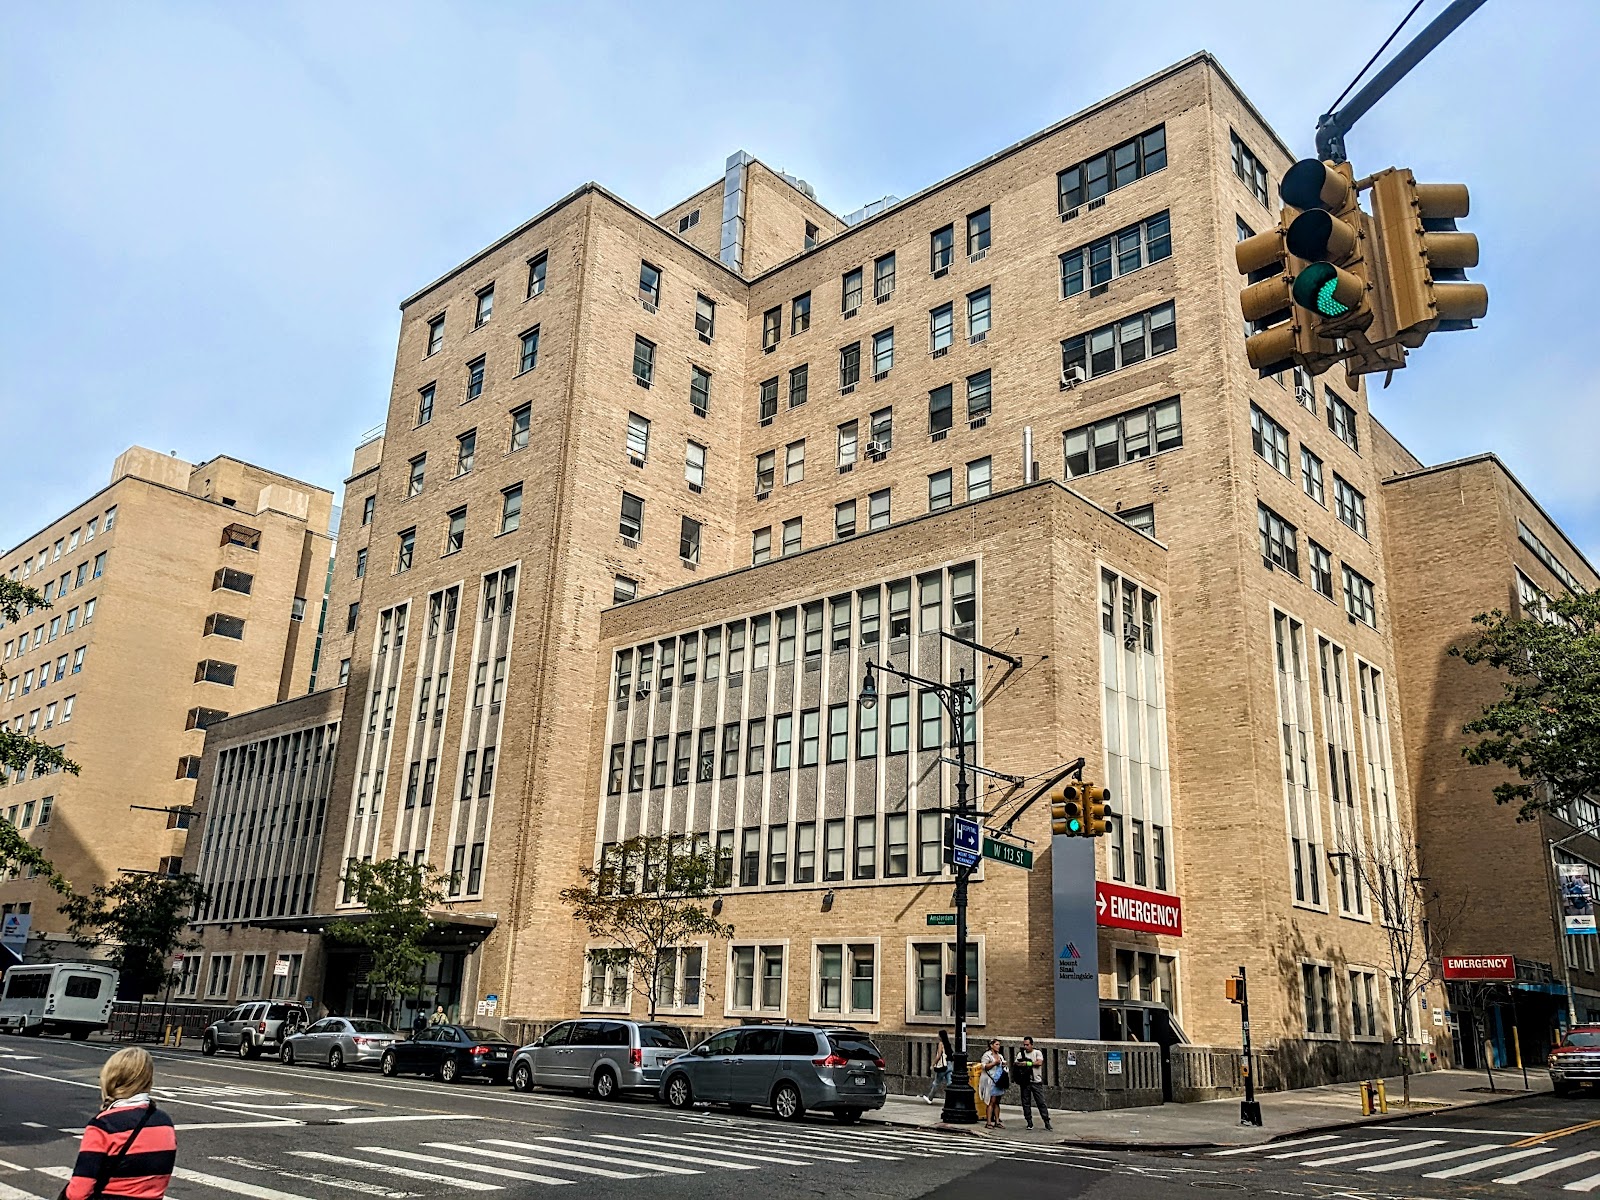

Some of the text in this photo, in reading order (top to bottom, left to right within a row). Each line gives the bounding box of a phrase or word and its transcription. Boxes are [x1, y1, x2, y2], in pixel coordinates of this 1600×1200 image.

[994, 843, 1024, 865] W 113 St
[1110, 896, 1179, 928] EMERGENCY
[1448, 958, 1508, 969] EMERGENCY
[1059, 973, 1094, 981] Morningside
